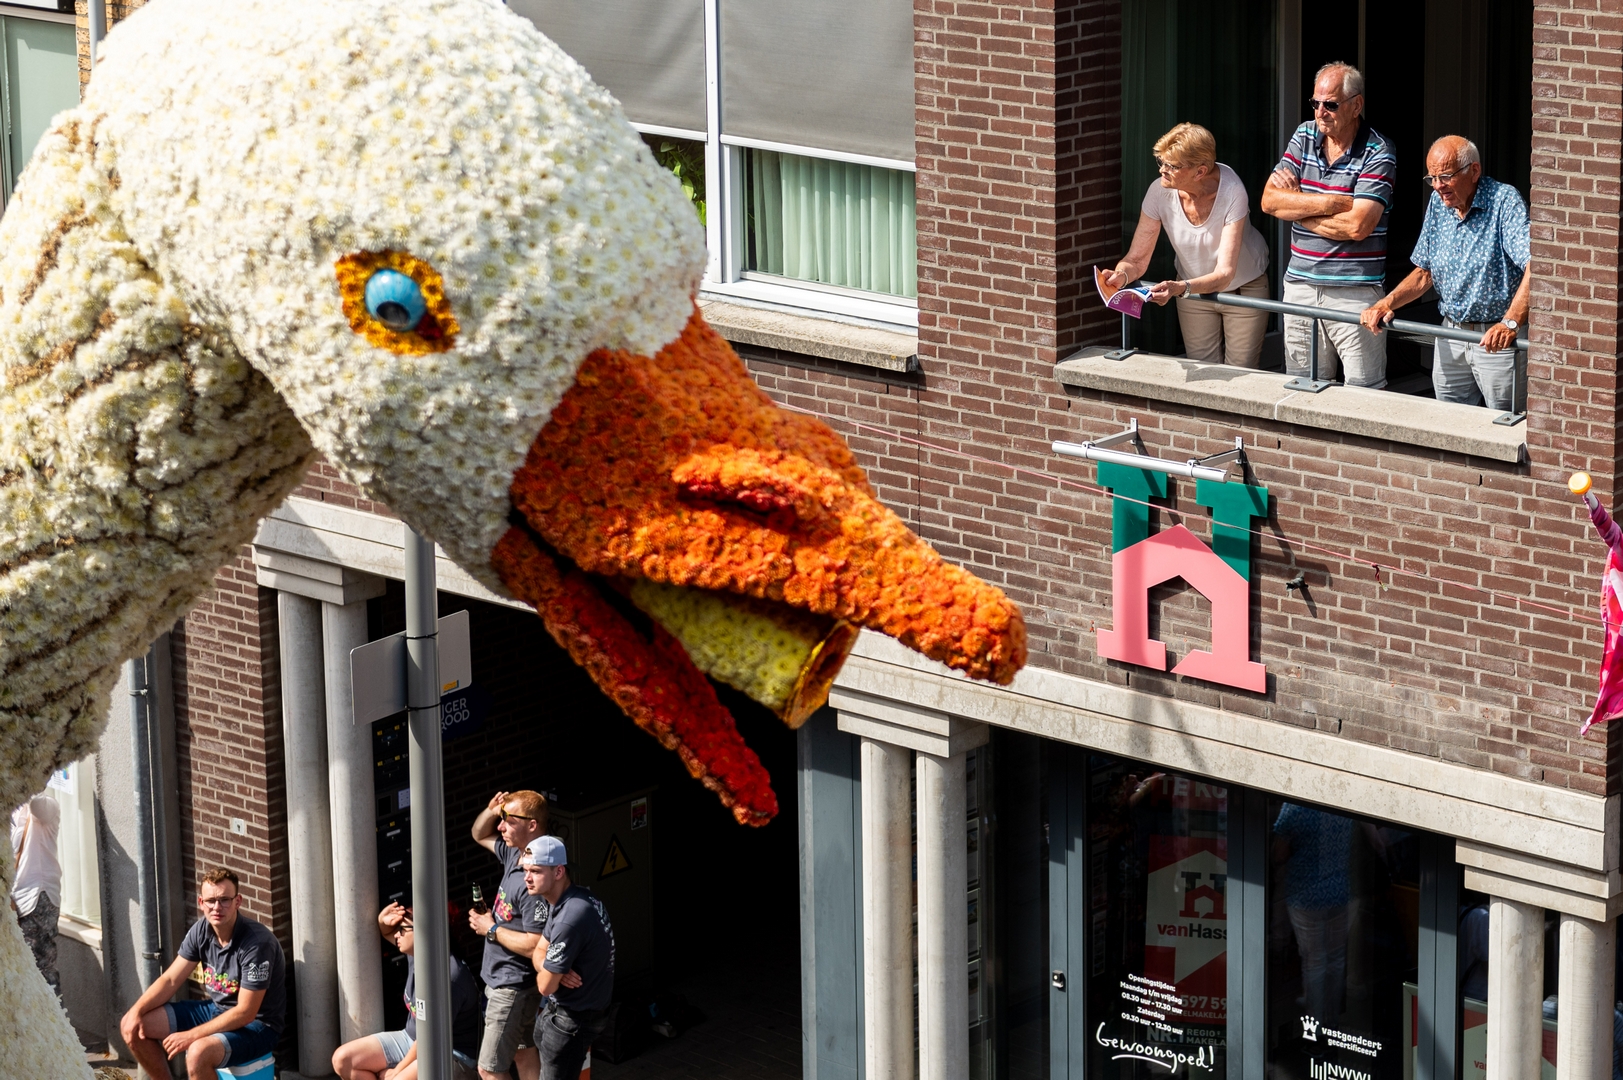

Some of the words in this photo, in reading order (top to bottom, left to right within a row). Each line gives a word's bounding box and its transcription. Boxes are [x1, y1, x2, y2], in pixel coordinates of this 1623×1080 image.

[1120, 981, 1147, 995] Maandag
[1148, 988, 1160, 998] t/m
[1161, 991, 1183, 1005] vrijdag
[1128, 973, 1176, 992] Openingstijden:
[1121, 992, 1139, 1003] 08.30
[1140, 998, 1151, 1006] uur
[1155, 1001, 1171, 1011] 17.30
[1172, 1006, 1183, 1014] uur
[1137, 1006, 1165, 1021] Zaterdag
[1121, 1012, 1139, 1023] 09.30
[1140, 1018, 1151, 1026] uur
[1155, 1021, 1171, 1032] 12.30
[1172, 1027, 1183, 1035] uur
[1187, 1028, 1216, 1038] REGIO
[1096, 1021, 1214, 1074] Gewoongoed!
[1321, 1027, 1382, 1050] vastgoedcert
[1327, 1038, 1377, 1057] gecertificeerd
